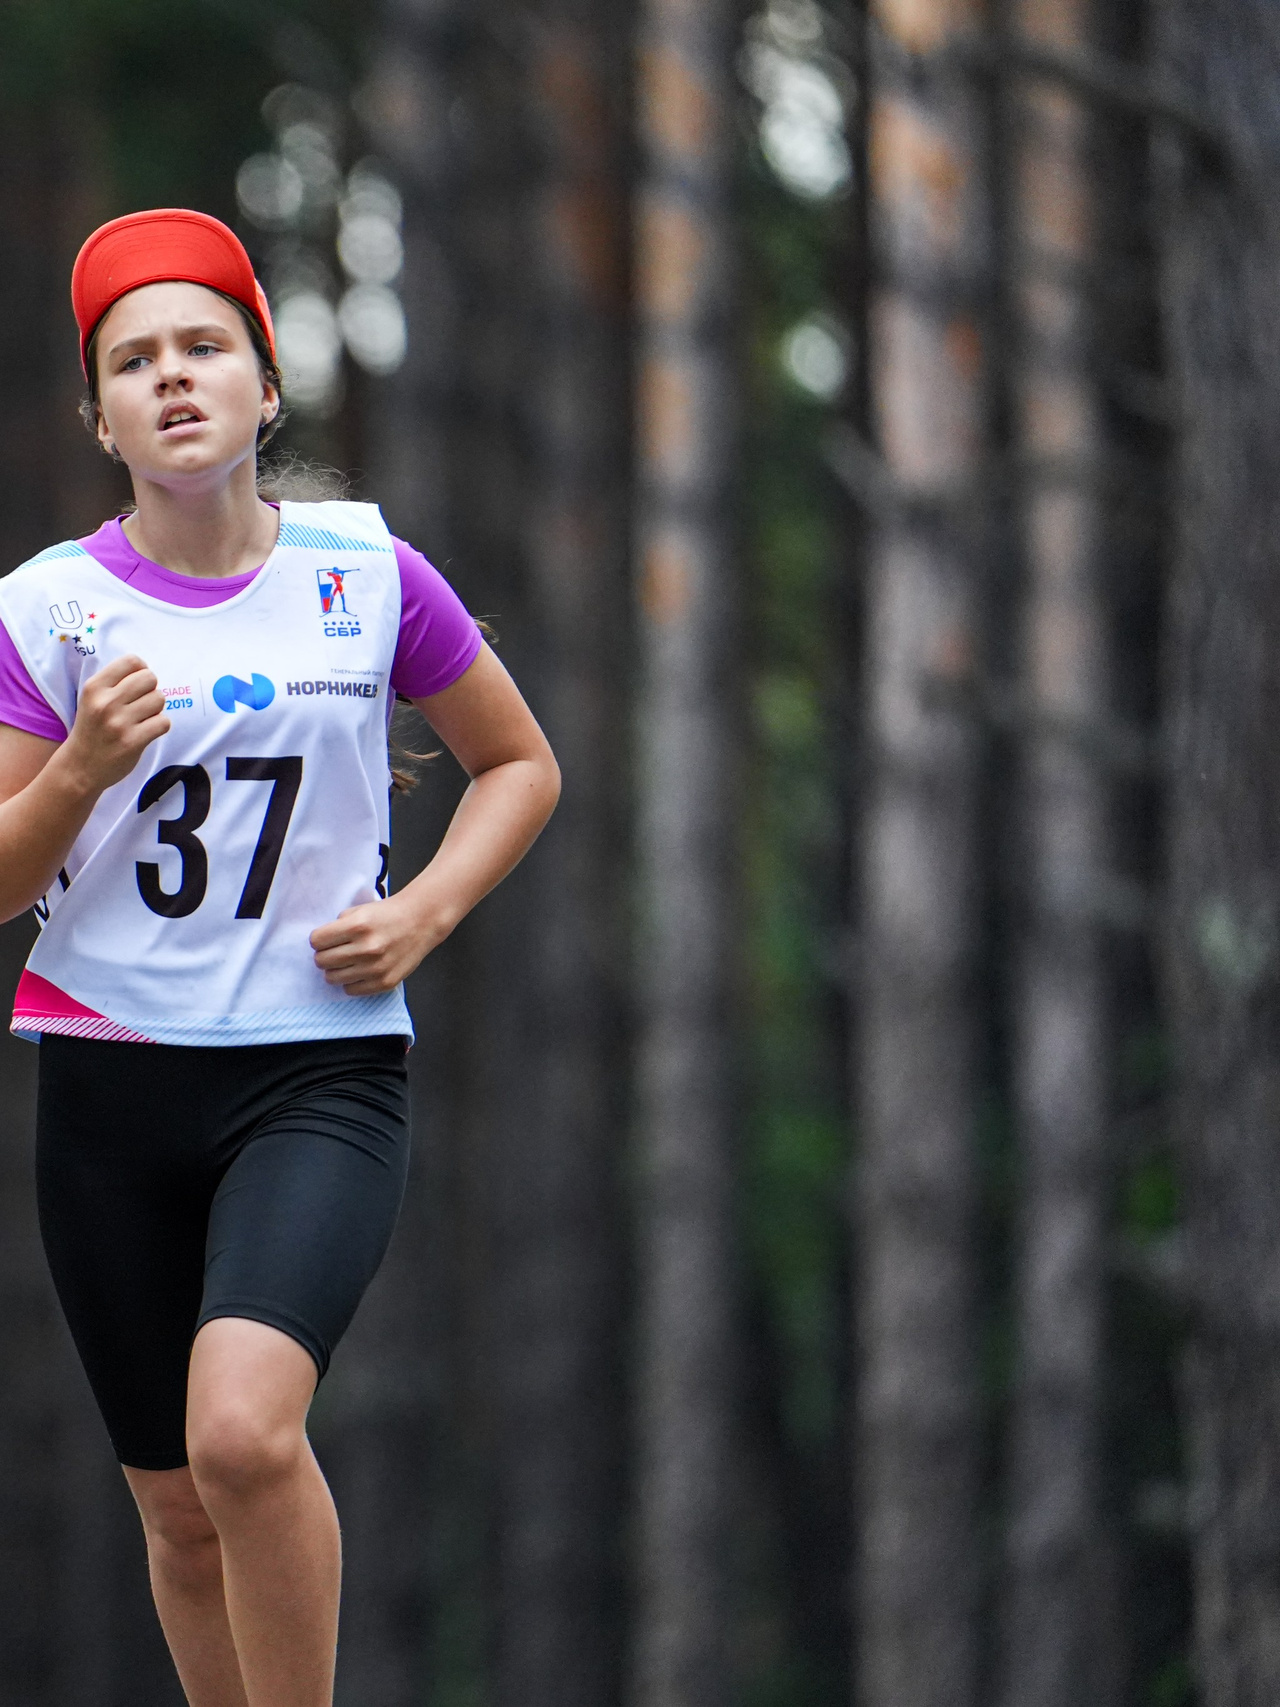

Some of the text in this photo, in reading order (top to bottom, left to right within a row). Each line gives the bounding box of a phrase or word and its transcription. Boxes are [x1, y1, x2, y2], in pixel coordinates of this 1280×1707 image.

[324, 627, 361, 637] СБР
[162, 686, 192, 697] SIADE
[165, 698, 193, 710] 2019
[135, 755, 303, 919] 37
